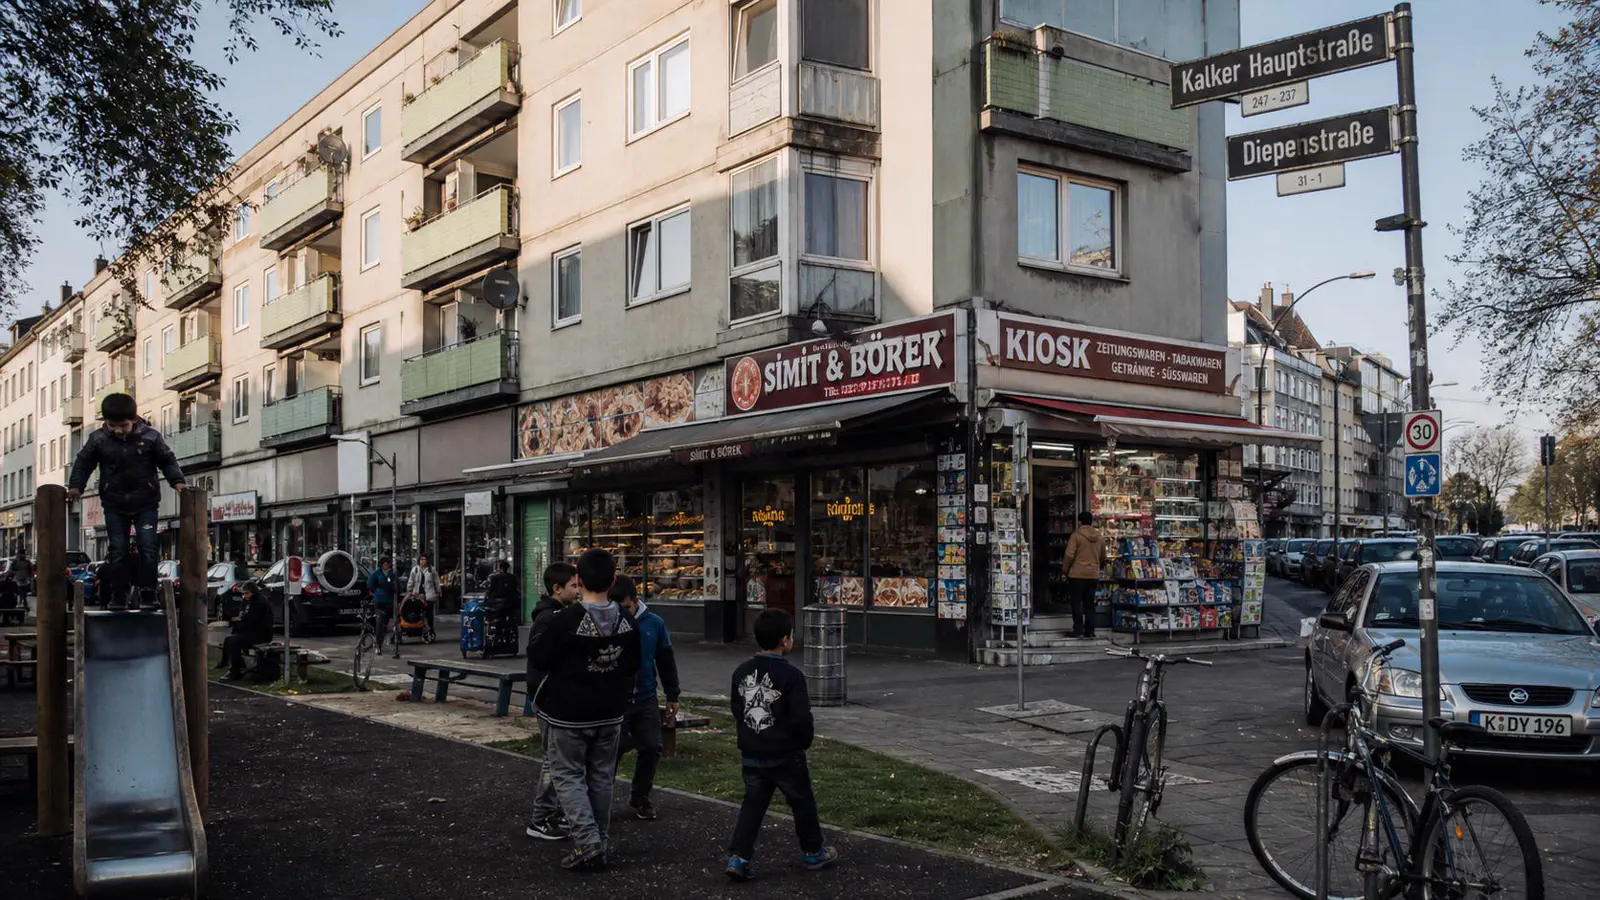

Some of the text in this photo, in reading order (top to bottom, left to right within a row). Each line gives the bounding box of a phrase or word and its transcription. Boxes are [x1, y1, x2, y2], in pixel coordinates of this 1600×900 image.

[1181, 29, 1373, 94] Kalker Hauptstraße
[1252, 96, 1269, 109] 247
[1280, 89, 1297, 103] 237
[1243, 120, 1375, 167] Diepenstraße
[1297, 176, 1307, 187] 31
[1318, 173, 1323, 184] 1
[1005, 327, 1092, 371] KIOSK
[1172, 353, 1222, 370] TABAKWAREN
[826, 350, 844, 382] &
[1412, 424, 1432, 441] 30
[1485, 715, 1565, 735] K DY 196
